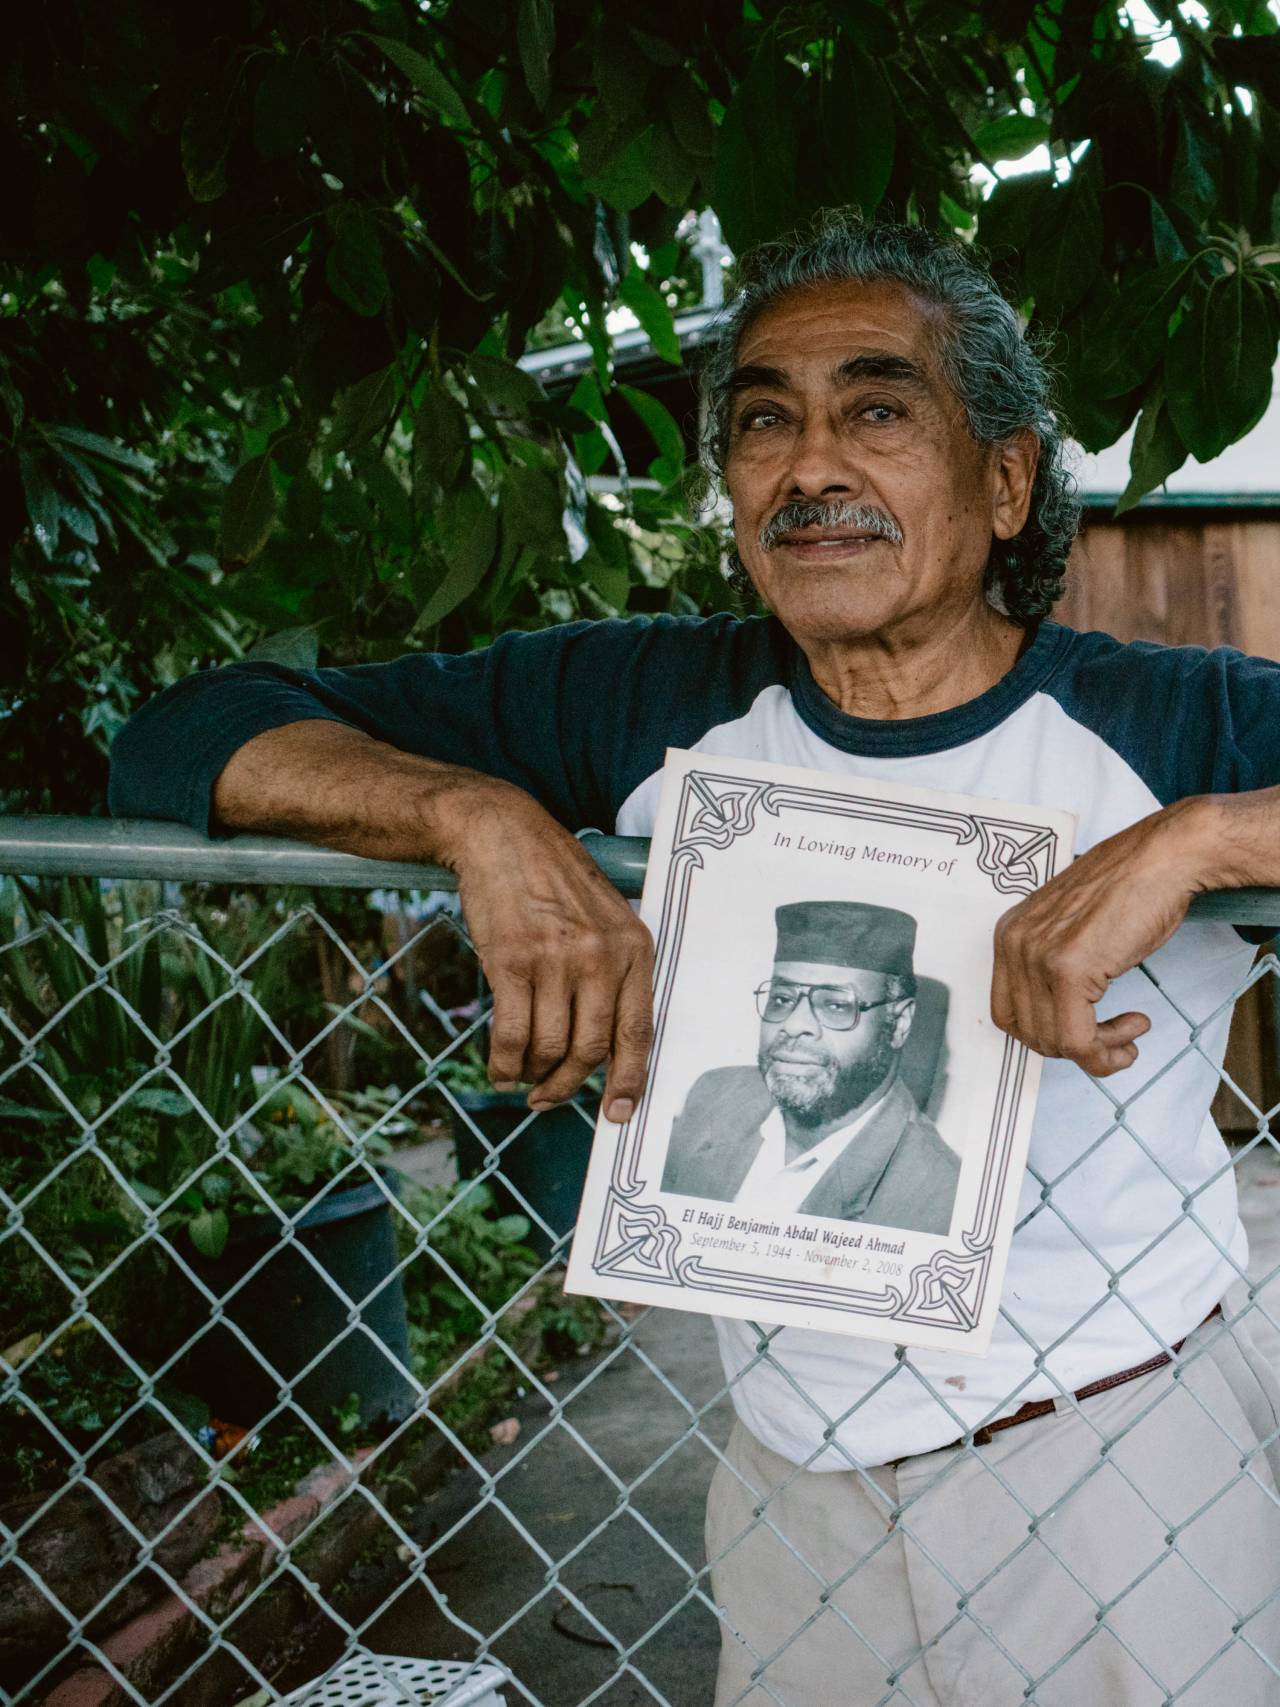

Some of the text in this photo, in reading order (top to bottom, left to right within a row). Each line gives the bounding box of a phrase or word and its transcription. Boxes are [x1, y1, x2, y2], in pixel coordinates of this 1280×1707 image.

[773, 832, 958, 876] In Loving Memory of
[682, 1209, 906, 1256] El Hajj Benjamin Abdul Wajeed Ahmad
[689, 1232, 746, 1253] September
[765, 1244, 792, 1260] 1944
[803, 1249, 858, 1270] November
[876, 1260, 904, 1276] 2008
